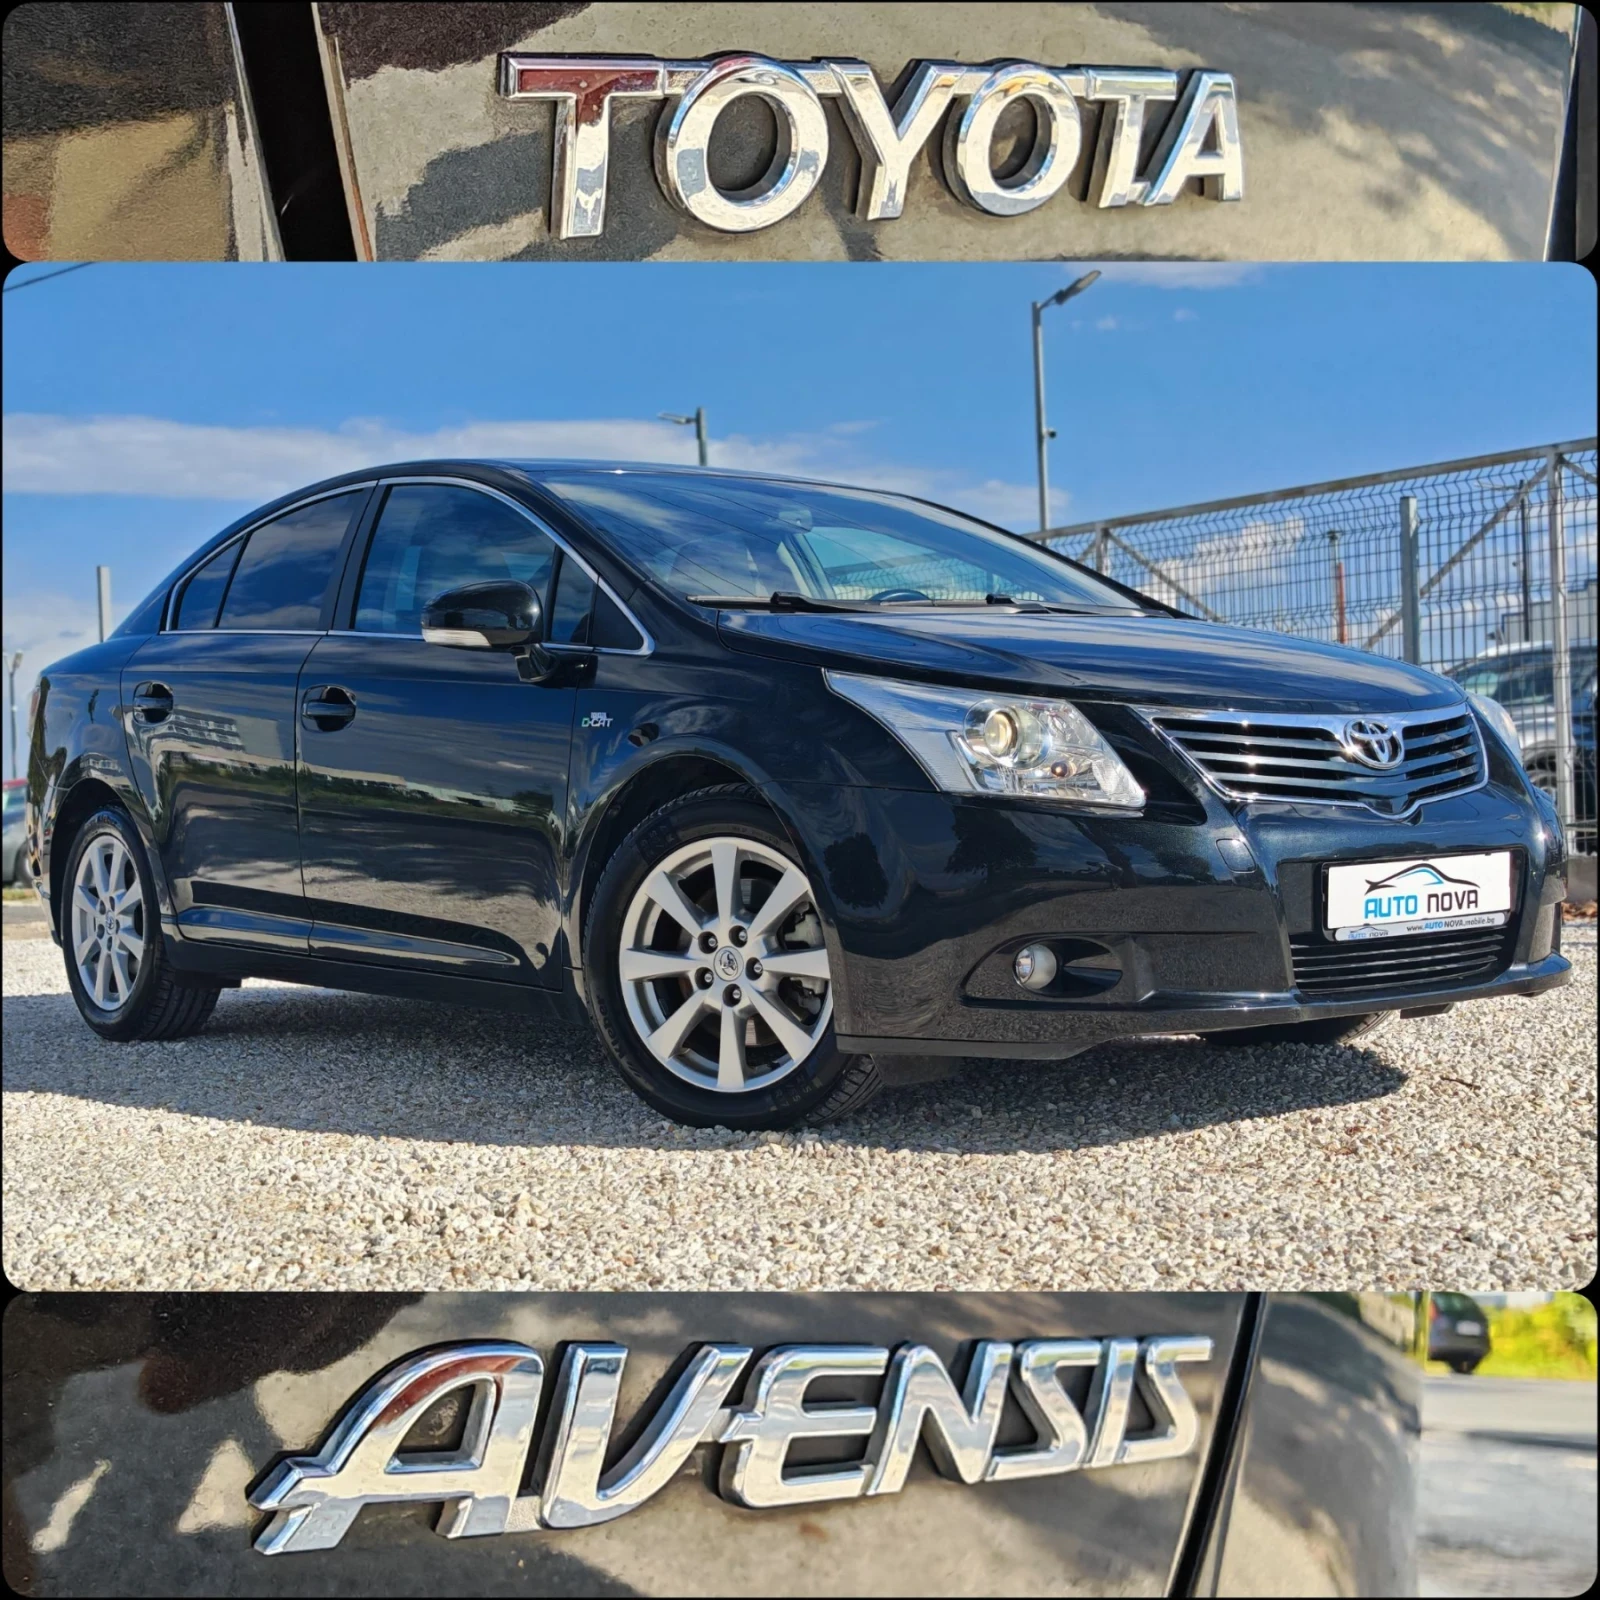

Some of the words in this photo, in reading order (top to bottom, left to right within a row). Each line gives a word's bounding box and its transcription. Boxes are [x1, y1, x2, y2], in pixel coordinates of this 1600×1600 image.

[499, 50, 1244, 240] TOYOTA
[1364, 894, 1418, 919] AUTO
[1427, 889, 1479, 914] NOVA
[248, 1335, 1215, 1556] AVENSIS
